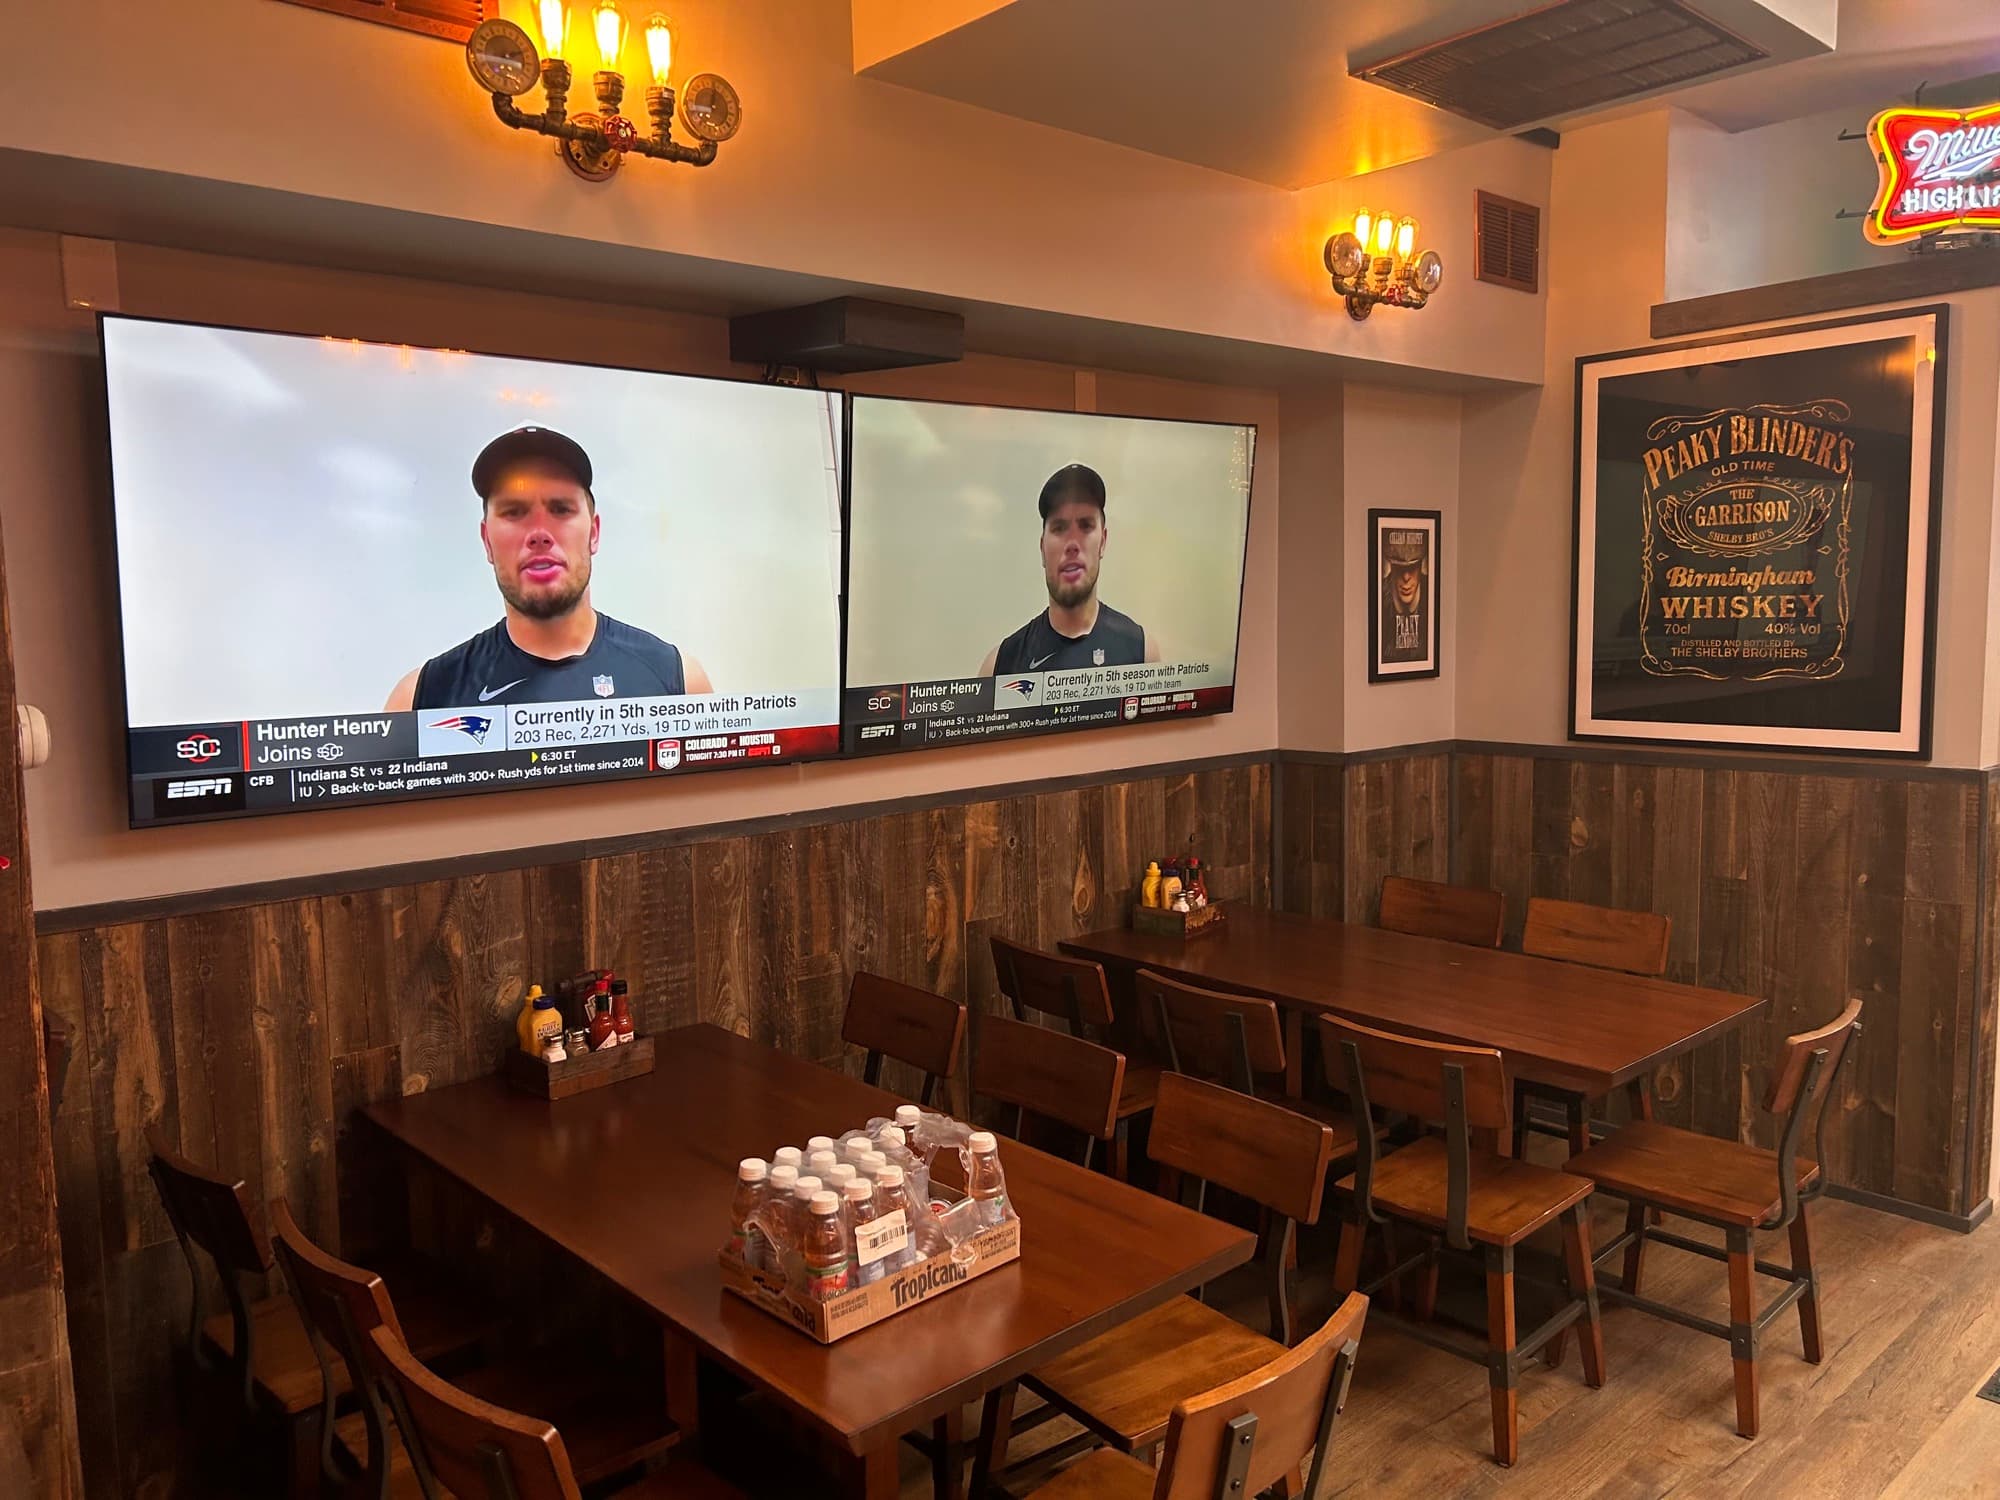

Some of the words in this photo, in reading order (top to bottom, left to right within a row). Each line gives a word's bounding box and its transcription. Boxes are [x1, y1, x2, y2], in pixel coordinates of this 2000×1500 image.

[1904, 184, 1963, 212] HIGH
[1642, 424, 1723, 490] PEAKY
[1730, 415, 1855, 474] BLINDER'S
[1711, 462, 1739, 476] OLD
[1741, 461, 1776, 472] TIME
[1729, 488, 1755, 500] THE
[1694, 500, 1791, 527] GARRISON
[1707, 530, 1744, 544] SHELBY
[1666, 564, 1816, 594] Birmingham
[1660, 594, 1824, 619] WHISKEY
[1663, 623, 1691, 635] 70cl
[1764, 623, 1796, 635] 40%
[1800, 623, 1821, 635] Vol
[1671, 647, 1692, 657] THE
[1694, 647, 1740, 658] SHELBY
[1742, 647, 1808, 658] BROTHERS
[1681, 639, 1722, 648] DISTILLED
[1723, 639, 1741, 648] AND
[1743, 639, 1781, 648] BOTTLED
[1783, 639, 1795, 648] BY
[1047, 672, 1093, 688] Currently
[1094, 671, 1103, 683] in
[1106, 669, 1120, 682] 5th
[1122, 667, 1155, 681] season
[1157, 664, 1176, 677] with
[1177, 661, 1210, 675] Patriots
[909, 684, 948, 698] Hunter
[950, 682, 982, 696] Henry
[1046, 689, 1061, 701] 203
[1063, 688, 1080, 699] Rec,
[1082, 685, 1104, 698] 2,271
[1106, 684, 1122, 695] Yds,
[1125, 682, 1134, 693] 19
[1136, 681, 1146, 691] TD
[1147, 679, 1163, 690] with
[1164, 679, 1182, 689] team
[514, 706, 595, 726] Currently
[599, 704, 614, 720] in
[619, 703, 644, 719] 5th
[649, 702, 705, 717] season
[709, 697, 739, 713] with
[743, 695, 797, 711] Patriots
[867, 696, 892, 711] SC
[908, 701, 938, 714] Joins
[256, 721, 328, 741] Hunter
[333, 718, 392, 738] Henry
[903, 722, 917, 731] CFB
[929, 718, 955, 728] Indiana
[956, 716, 965, 725] St
[976, 714, 984, 723] 22
[985, 713, 1010, 722] Indiana
[945, 727, 985, 737] Back-to-back
[985, 724, 1005, 734] games
[1019, 720, 1034, 729] 300+
[514, 731, 541, 744] 203
[545, 728, 576, 743] Rec,
[580, 724, 616, 741] 2,271
[621, 722, 650, 737] Yds,
[655, 720, 670, 733] 19
[673, 719, 691, 732] TD
[694, 716, 719, 730] with
[722, 716, 752, 729] team
[861, 724, 895, 739] ESPN
[176, 738, 221, 759] SC
[685, 736, 728, 751] COLORADO
[739, 733, 775, 747] HOUSTON
[257, 744, 312, 764] Joins
[540, 751, 562, 762] 6:30
[564, 749, 577, 760] ET
[685, 751, 713, 762] TONIGHT
[727, 749, 738, 758] PM
[738, 748, 746, 757] ET
[298, 769, 347, 783] Indiana
[349, 766, 366, 778] St
[370, 767, 383, 776] vs
[388, 763, 401, 775] 22
[403, 760, 449, 774] Indiana
[299, 786, 313, 798] IU
[331, 778, 405, 796] Back-to-back
[406, 776, 442, 790] games
[443, 772, 466, 785] with
[468, 770, 495, 783] 300+
[497, 768, 523, 780] Rush
[524, 766, 542, 780] yds
[543, 764, 557, 776] for
[558, 763, 573, 775] 1st
[574, 762, 596, 773] time
[596, 759, 621, 771] since
[622, 757, 644, 768] 2014
[167, 777, 232, 799] ESPN
[249, 775, 274, 787] CFB
[890, 1262, 967, 1308] Tropicana
